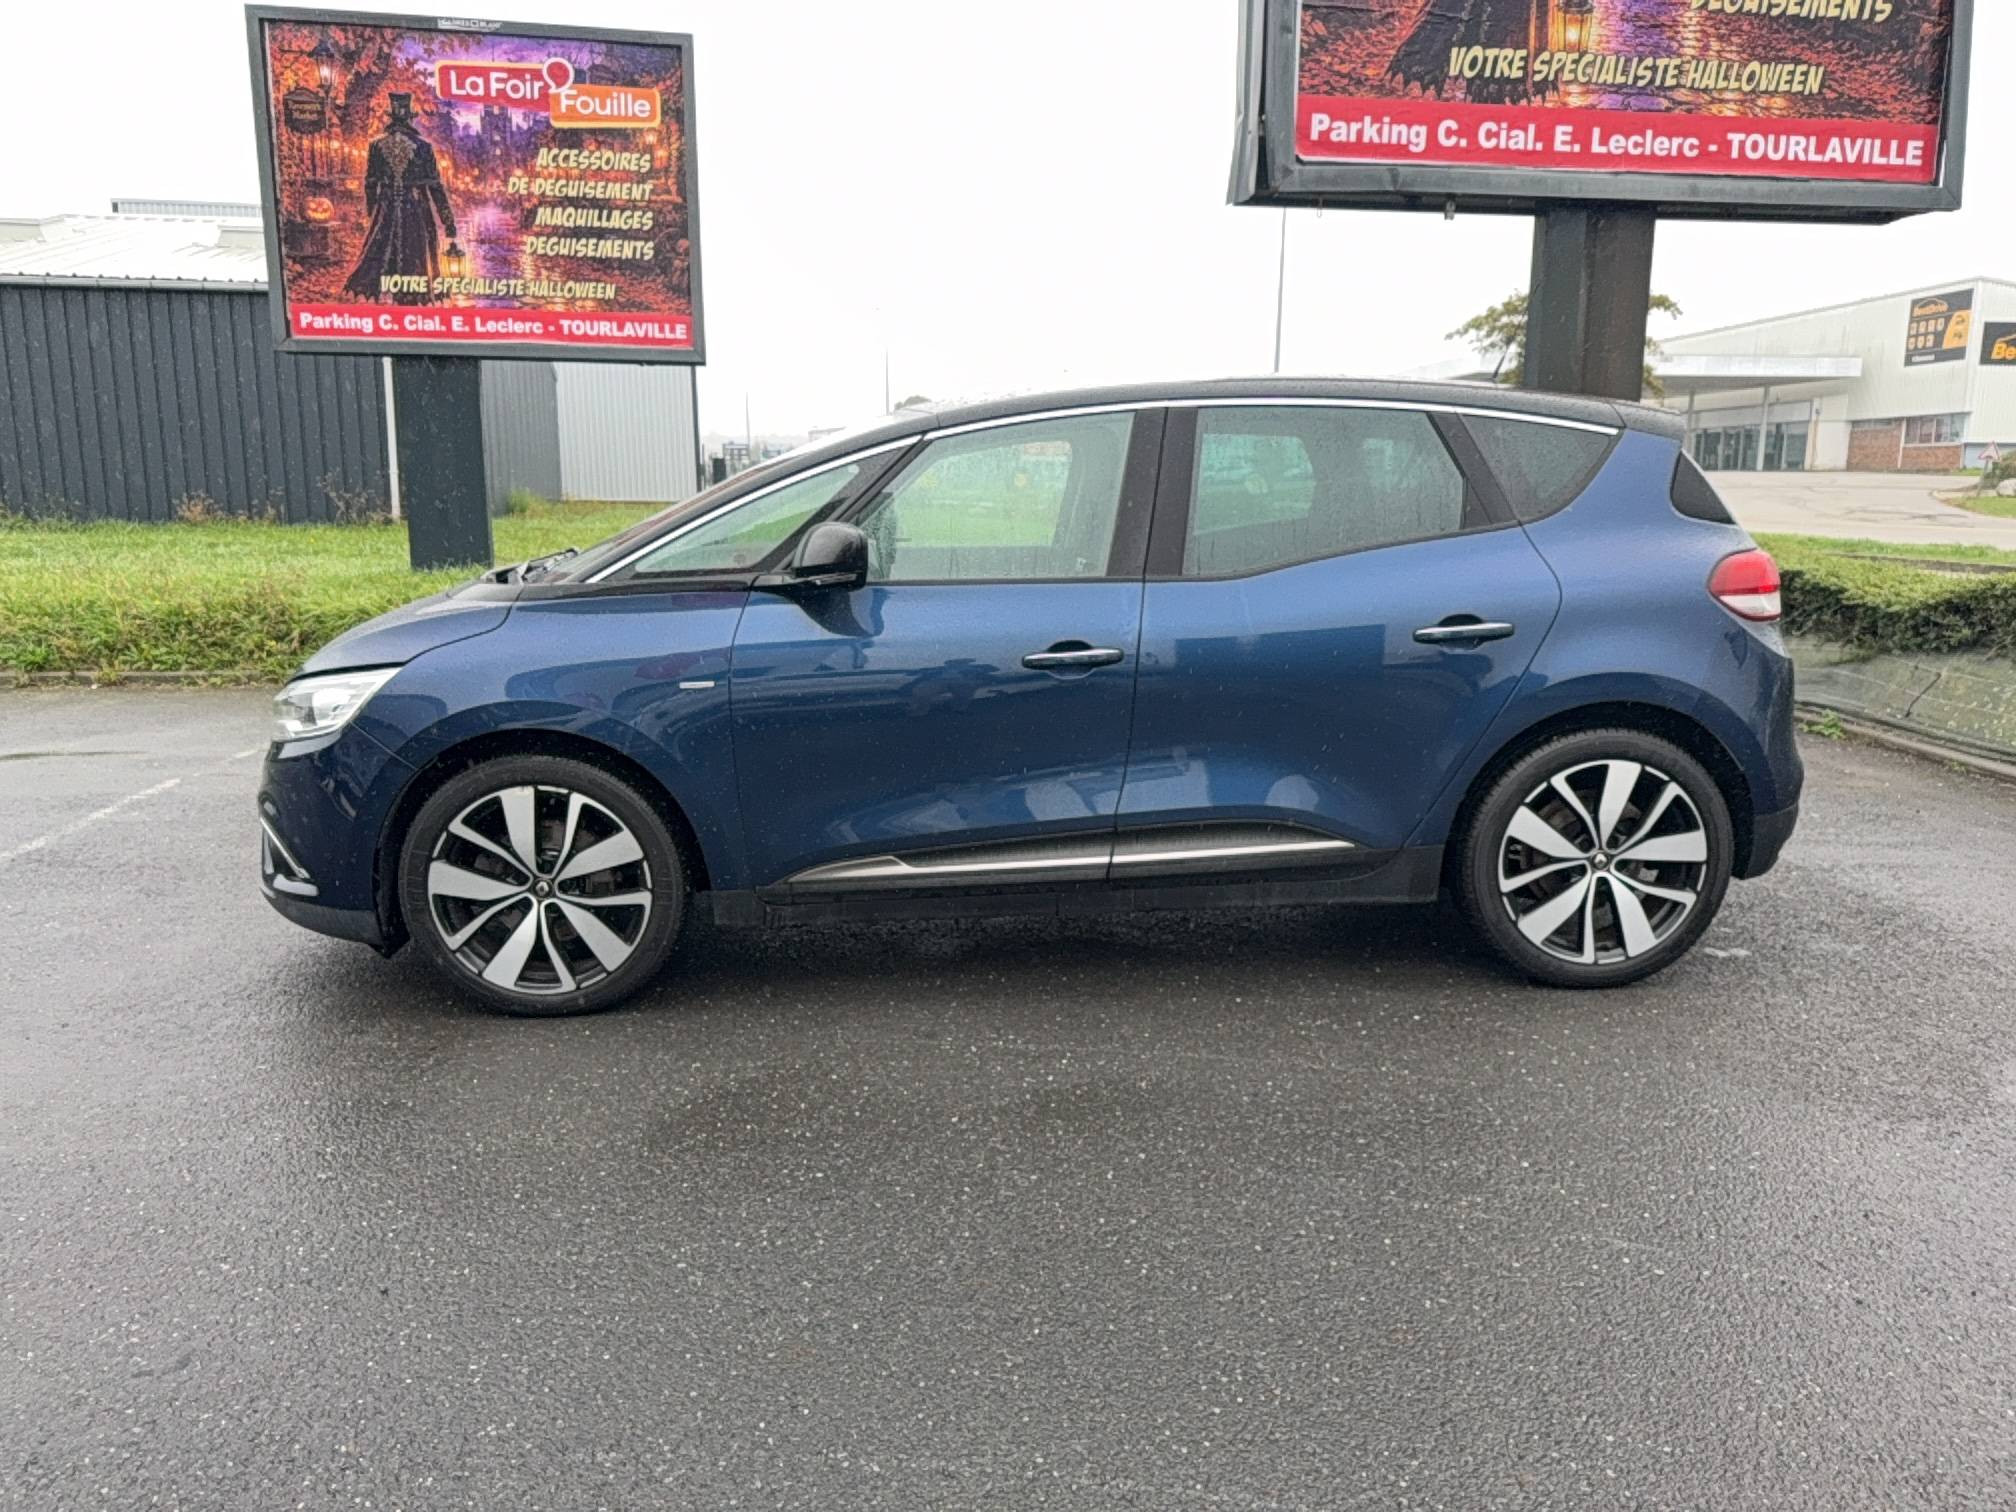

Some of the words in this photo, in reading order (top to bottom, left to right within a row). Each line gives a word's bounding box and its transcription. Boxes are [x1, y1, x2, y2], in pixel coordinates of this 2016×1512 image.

[1690, 0, 1893, 23] ISEMENTS
[1448, 46, 1527, 79] VOTRE
[1533, 52, 1681, 87] SPECIALISTE
[1688, 59, 1824, 95] HALLOWEEN
[560, 89, 651, 117] Fouille
[1310, 112, 1427, 152] Parking
[1437, 120, 1467, 147] C.
[1478, 121, 1543, 151] Cial.
[1554, 125, 1580, 152] E.
[1591, 127, 1700, 157] Leclerc
[1727, 133, 1924, 166] TOURLAVILLE
[536, 147, 652, 173] ACCESSOIRES
[508, 177, 529, 195] DE
[534, 177, 654, 201] DEGUISEMENT
[535, 206, 654, 231] MAQUILLAGES
[525, 236, 655, 260] DEGUISEMENTS
[380, 274, 429, 293] VOTRE
[434, 277, 524, 296] SPECIALISTE
[529, 279, 617, 299] HALLOWEEN
[300, 312, 373, 333] Parking
[379, 314, 399, 331] C.
[451, 316, 470, 333] E.
[475, 316, 543, 334] Leclerc
[559, 319, 688, 340] TOURLAVILLE
